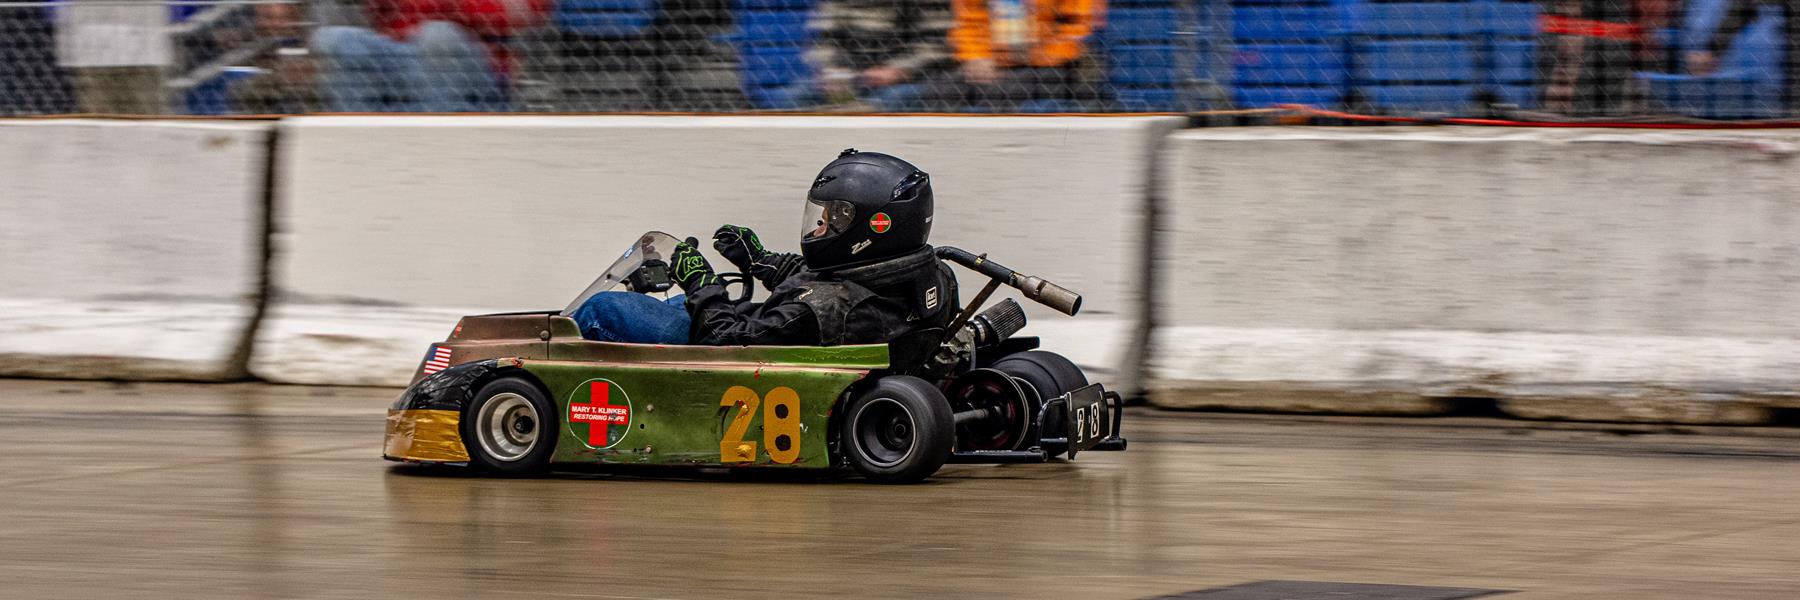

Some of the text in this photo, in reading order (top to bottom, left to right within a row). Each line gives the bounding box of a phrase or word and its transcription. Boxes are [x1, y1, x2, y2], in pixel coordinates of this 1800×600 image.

[571, 405, 590, 413] MARY
[598, 407, 627, 415] KLINKER
[574, 413, 607, 421] RESTORING
[1077, 402, 1100, 443] 28
[720, 386, 800, 464] 28
